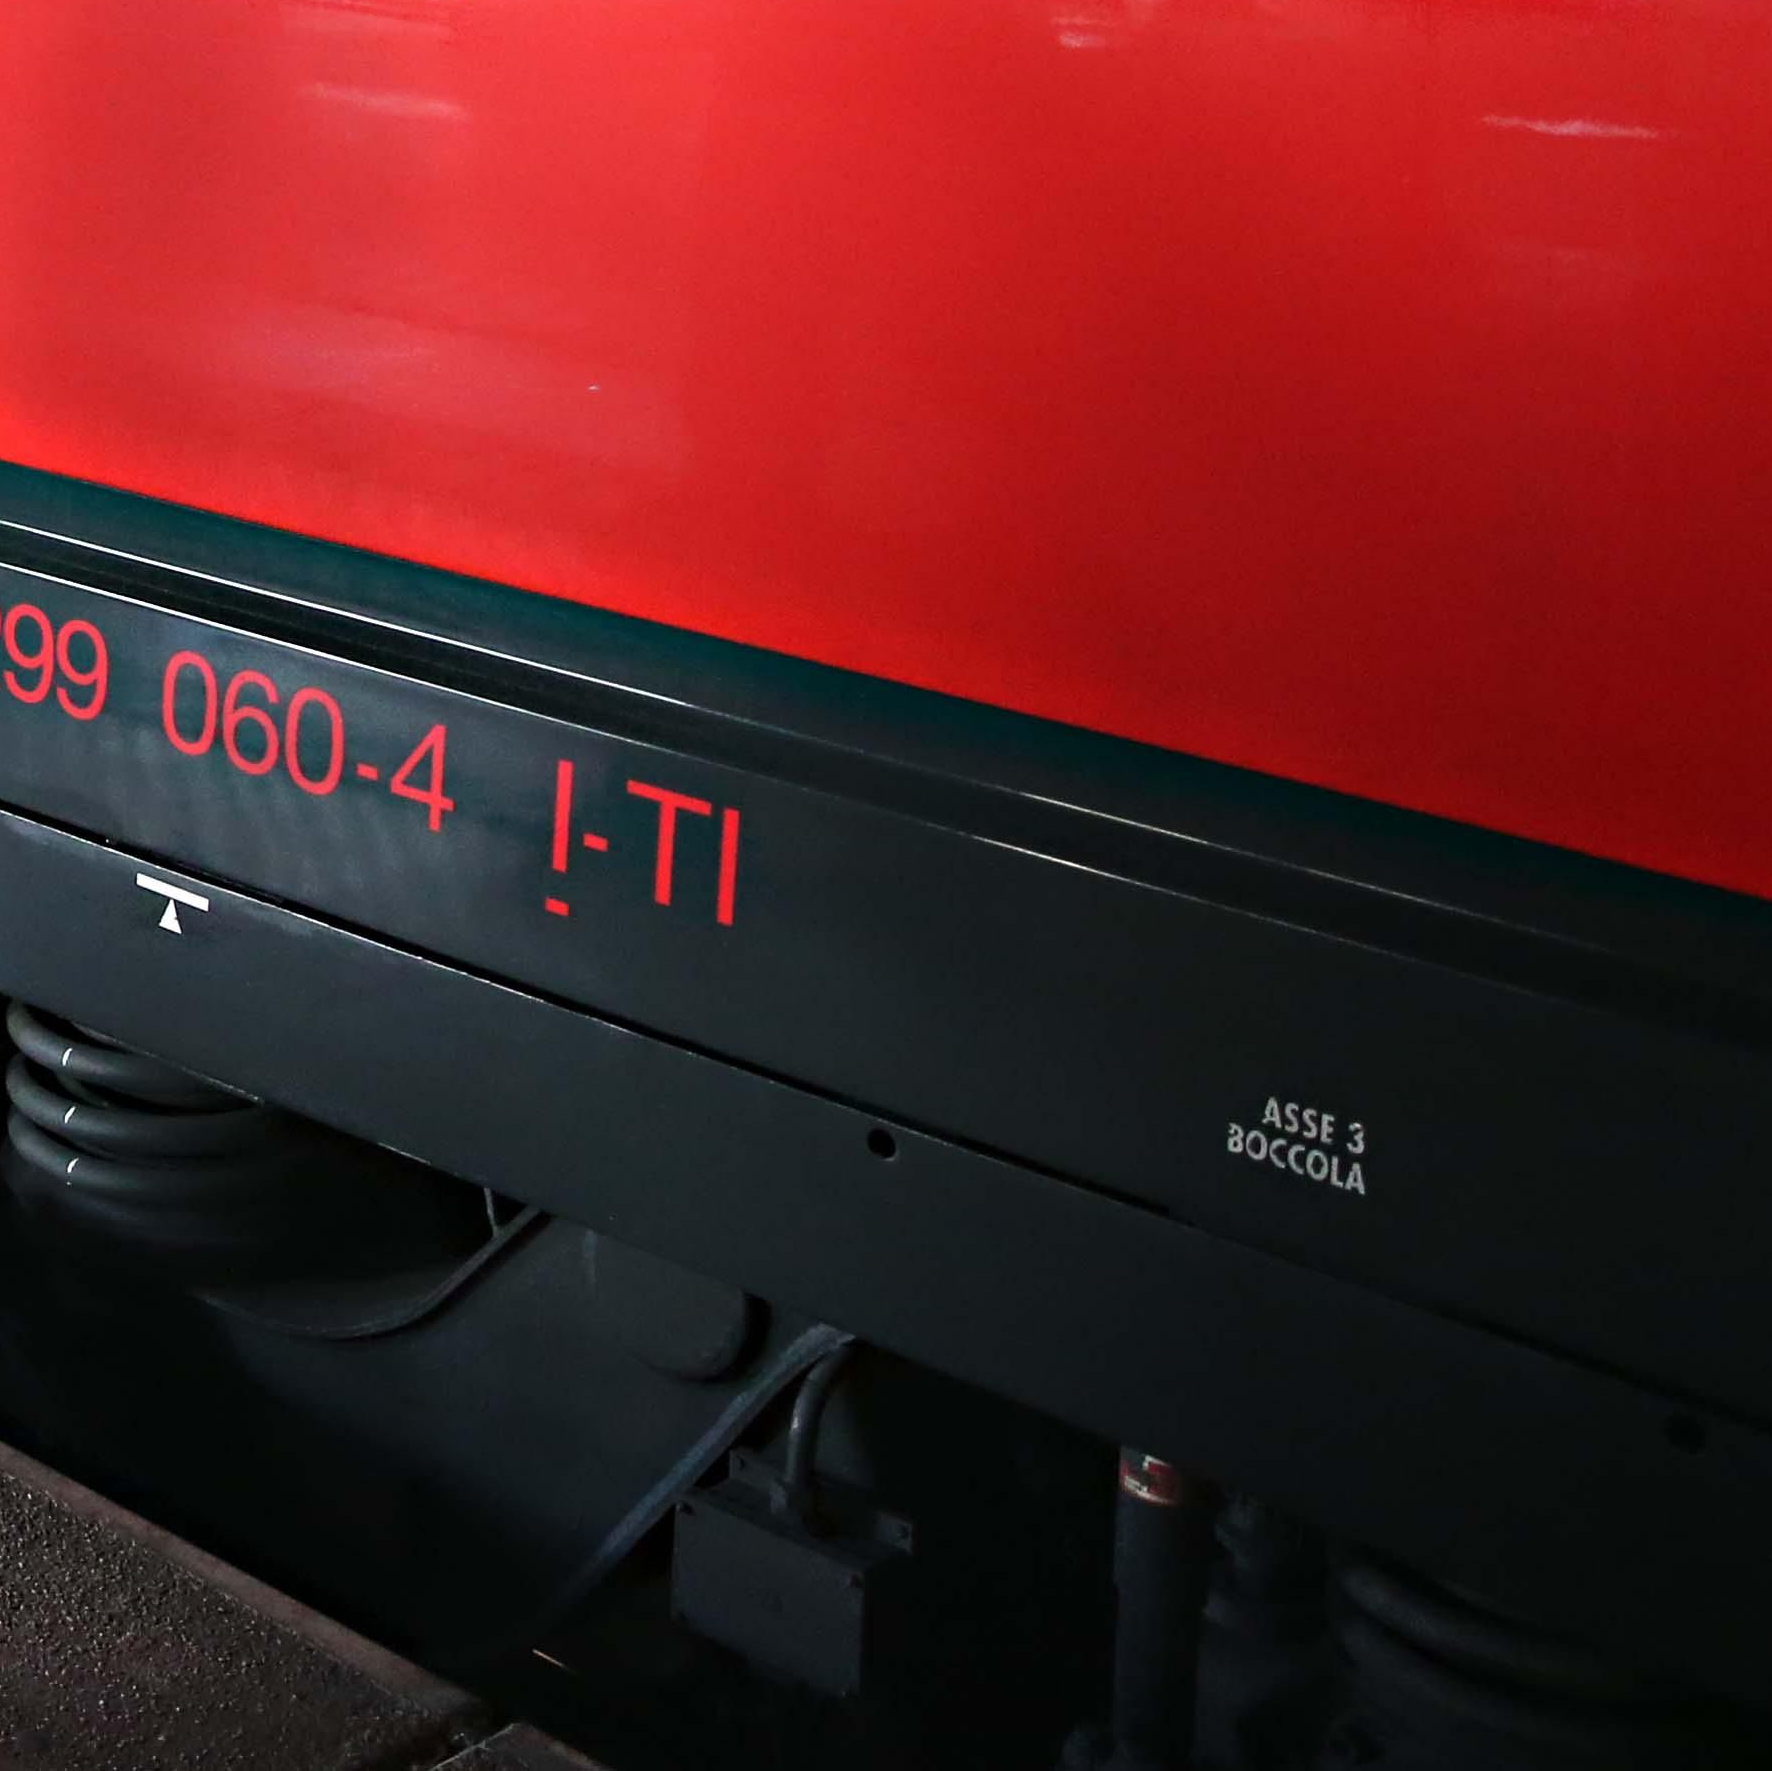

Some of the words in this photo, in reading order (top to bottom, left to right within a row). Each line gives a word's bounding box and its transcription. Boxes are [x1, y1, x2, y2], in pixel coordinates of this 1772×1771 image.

[161, 648, 456, 832] 060-4
[1226, 1121, 1366, 1195] BOCCOLA
[1261, 1096, 1335, 1145] ASSE
[1346, 1121, 1365, 1155] 3
